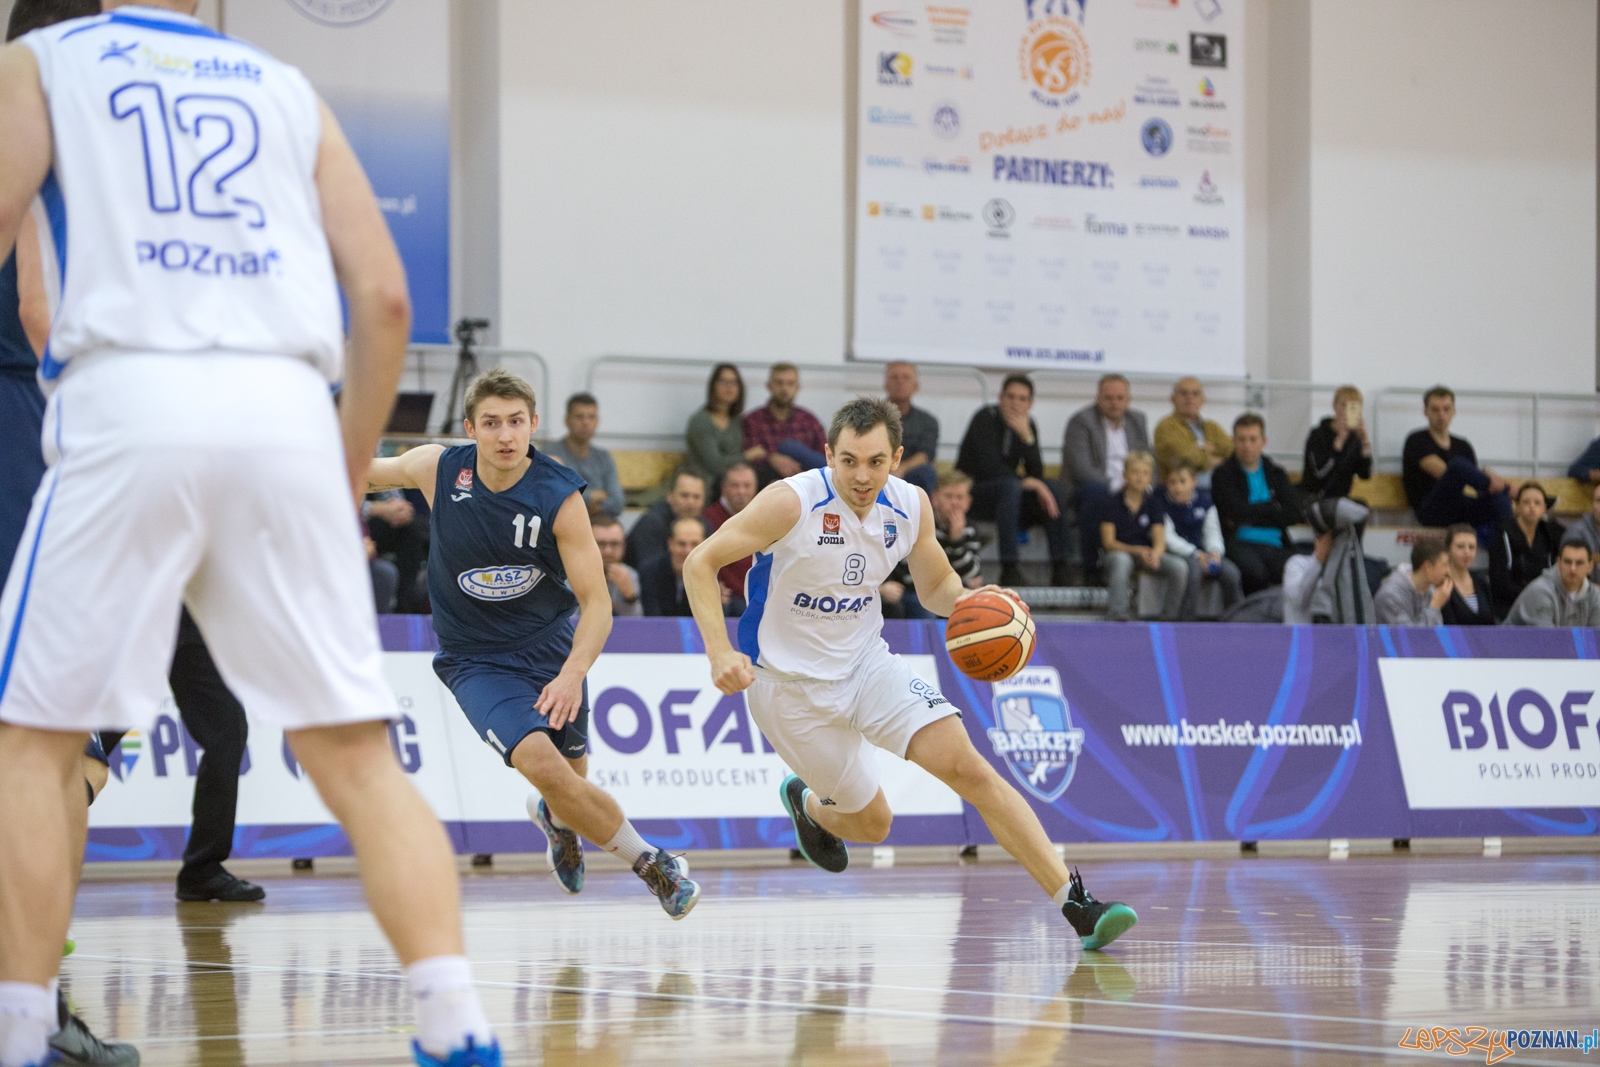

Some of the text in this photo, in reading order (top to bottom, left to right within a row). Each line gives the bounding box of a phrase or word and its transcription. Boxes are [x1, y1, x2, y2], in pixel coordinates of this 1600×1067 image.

[109, 82, 265, 228] 12
[993, 154, 1114, 189] PARTNERZY:
[512, 513, 542, 549] 11
[481, 570, 523, 583] MASZ
[842, 553, 866, 586] 8
[469, 578, 534, 596] GLIWICE
[790, 607, 819, 619] POLSKI
[1441, 688, 1600, 750] BIOF
[991, 730, 1083, 752] BASKET
[1120, 717, 1362, 751] www.basket.poznan.pl
[642, 767, 770, 787] PRODUCENT
[1479, 762, 1600, 780] POLSKI PROD
